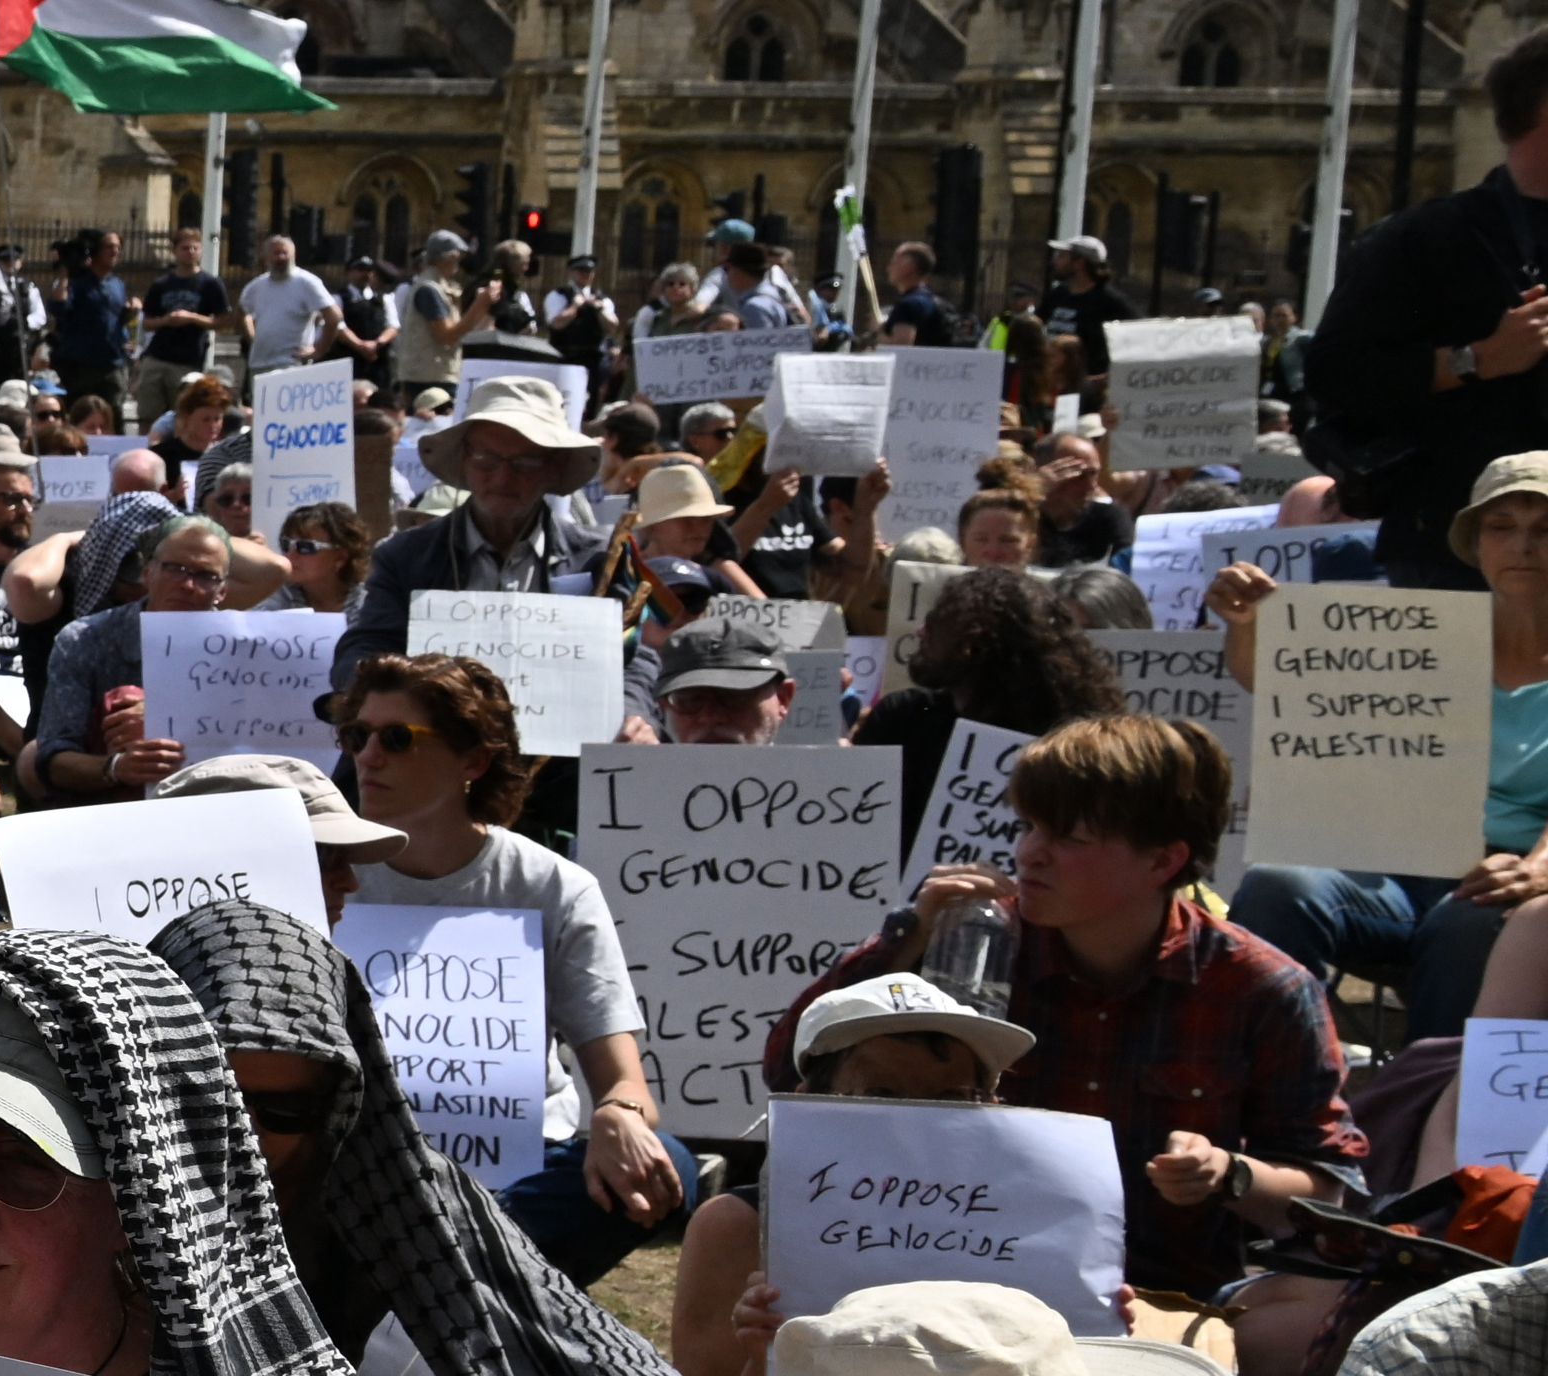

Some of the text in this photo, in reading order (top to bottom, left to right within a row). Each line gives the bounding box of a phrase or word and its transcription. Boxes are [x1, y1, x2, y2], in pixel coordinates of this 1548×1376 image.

[653, 340, 724, 356] OPPOSE
[646, 378, 738, 398] PALESTINE
[1128, 366, 1238, 388] GENOCIDE
[261, 383, 345, 415] I OPPOSE
[264, 422, 346, 458] GENOCIDE
[289, 482, 340, 506] SUPPORT
[450, 600, 562, 624] OPPOSE
[1287, 603, 1438, 631] I OPPOSE
[204, 634, 323, 660] OPPOSE
[422, 634, 582, 661] GENOCIDE
[1276, 648, 1437, 672] GENOCIDE
[189, 661, 322, 691] GENOCIDE
[1273, 694, 1450, 718] I SUPPORT
[197, 717, 303, 736] SUPPORT
[1270, 732, 1444, 759] PALESTINE
[593, 767, 890, 832] I OPPOSE
[127, 873, 252, 918] OPPOSE
[365, 950, 522, 1002] OPPOSE
[809, 1162, 998, 1216] I OPPOSE
